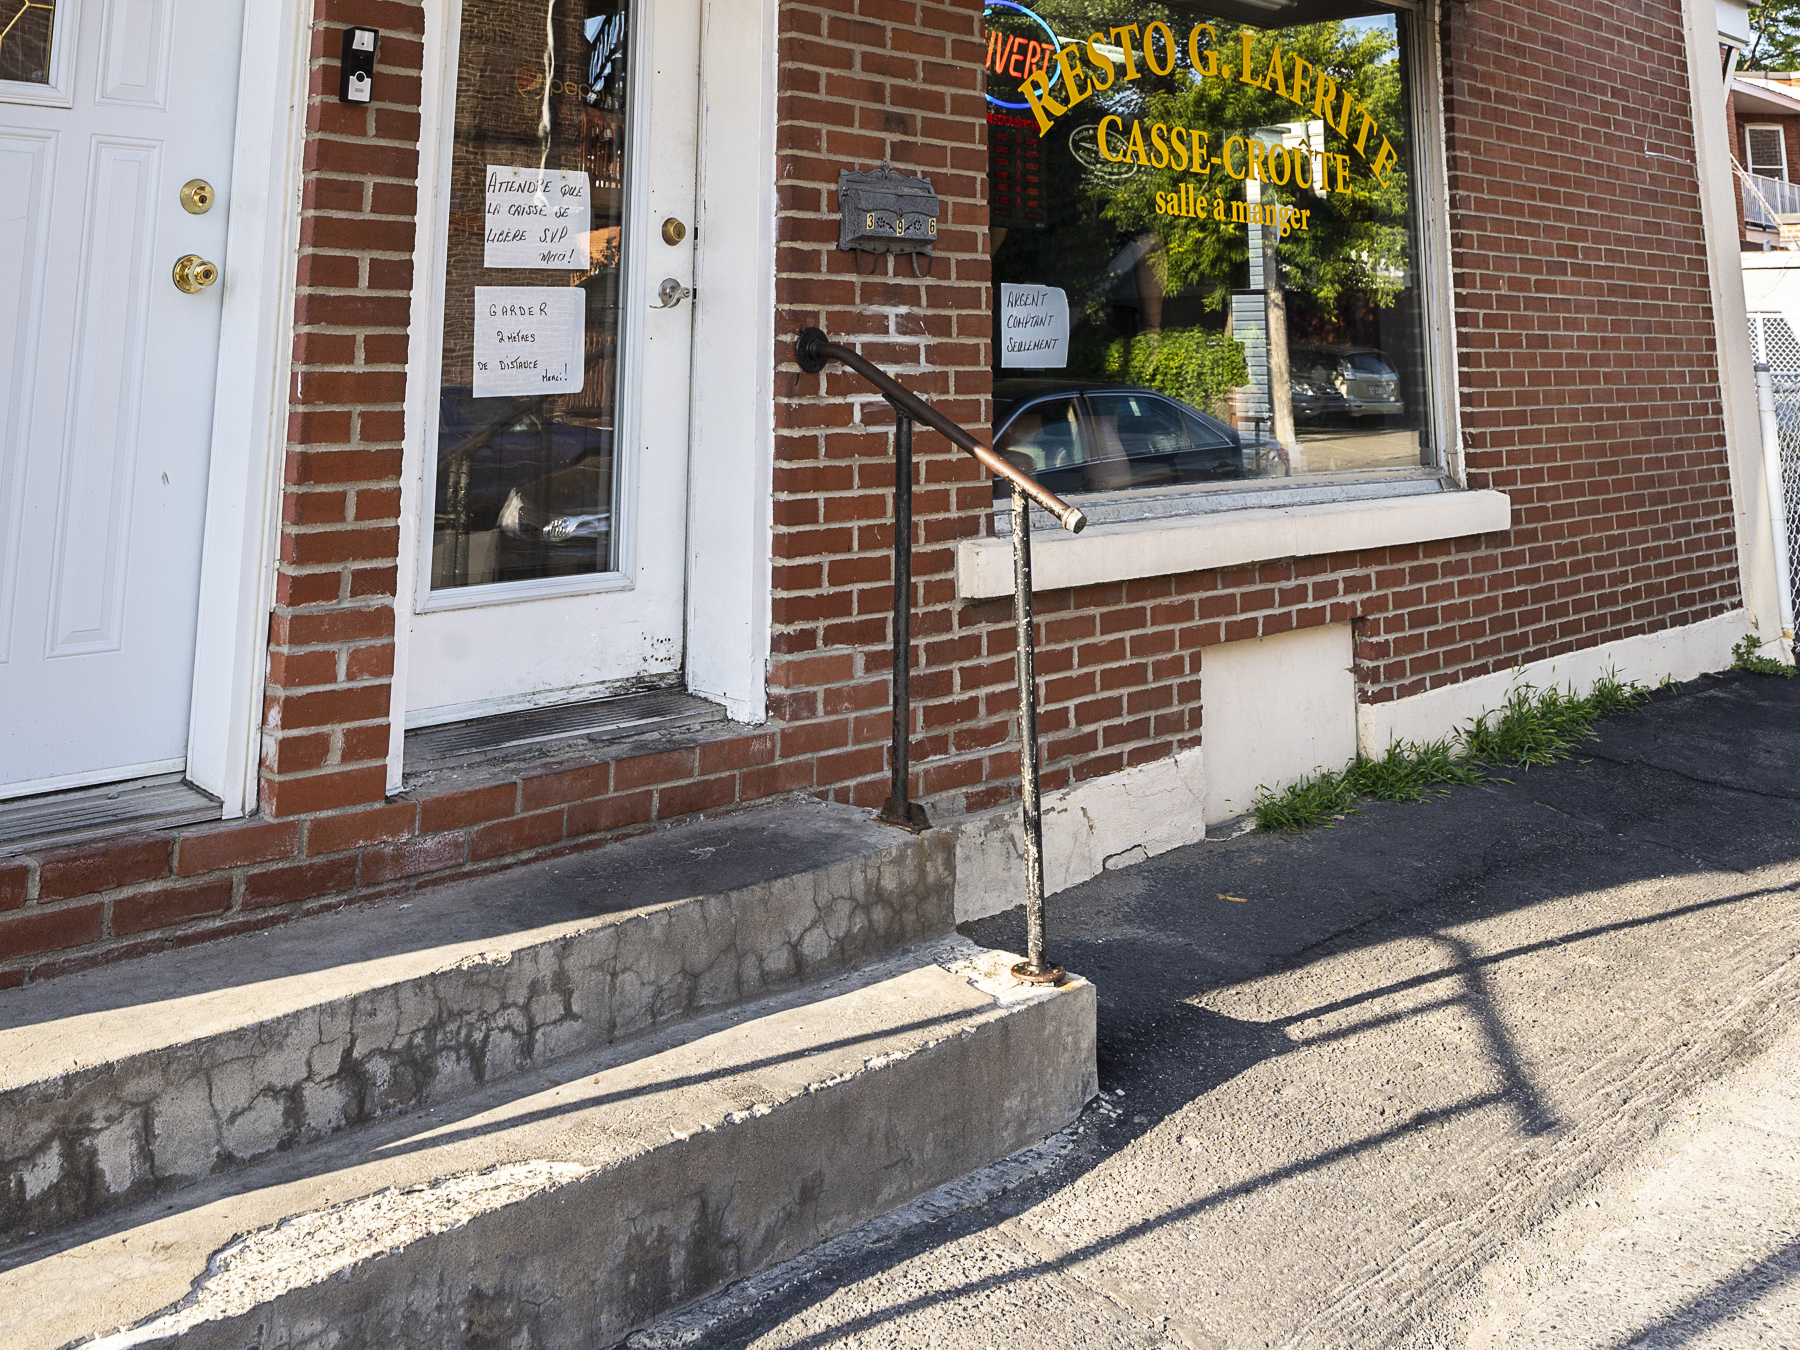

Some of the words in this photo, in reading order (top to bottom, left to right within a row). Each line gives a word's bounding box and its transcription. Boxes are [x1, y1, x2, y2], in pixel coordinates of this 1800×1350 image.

[984, 29, 1055, 81] UVERT
[1017, 21, 1176, 138] RESTO
[1188, 23, 1230, 79] G.
[1238, 29, 1397, 189] LAFRITE
[1097, 114, 1353, 194] CASSE-CROÛTE
[487, 171, 552, 193] ATTENDRE
[560, 184, 583, 197] QUE
[487, 202, 501, 216] LA
[555, 206, 570, 218] SE
[1155, 182, 1207, 219] salle
[1213, 189, 1226, 221] à
[1230, 199, 1311, 237] manger
[1007, 290, 1048, 308] ARGENT
[489, 302, 548, 317] GARDER
[1007, 312, 1055, 329] COMPTANT
[496, 330, 505, 343] 2
[1006, 337, 1059, 353] SEULEMENT
[478, 361, 488, 370] DE
